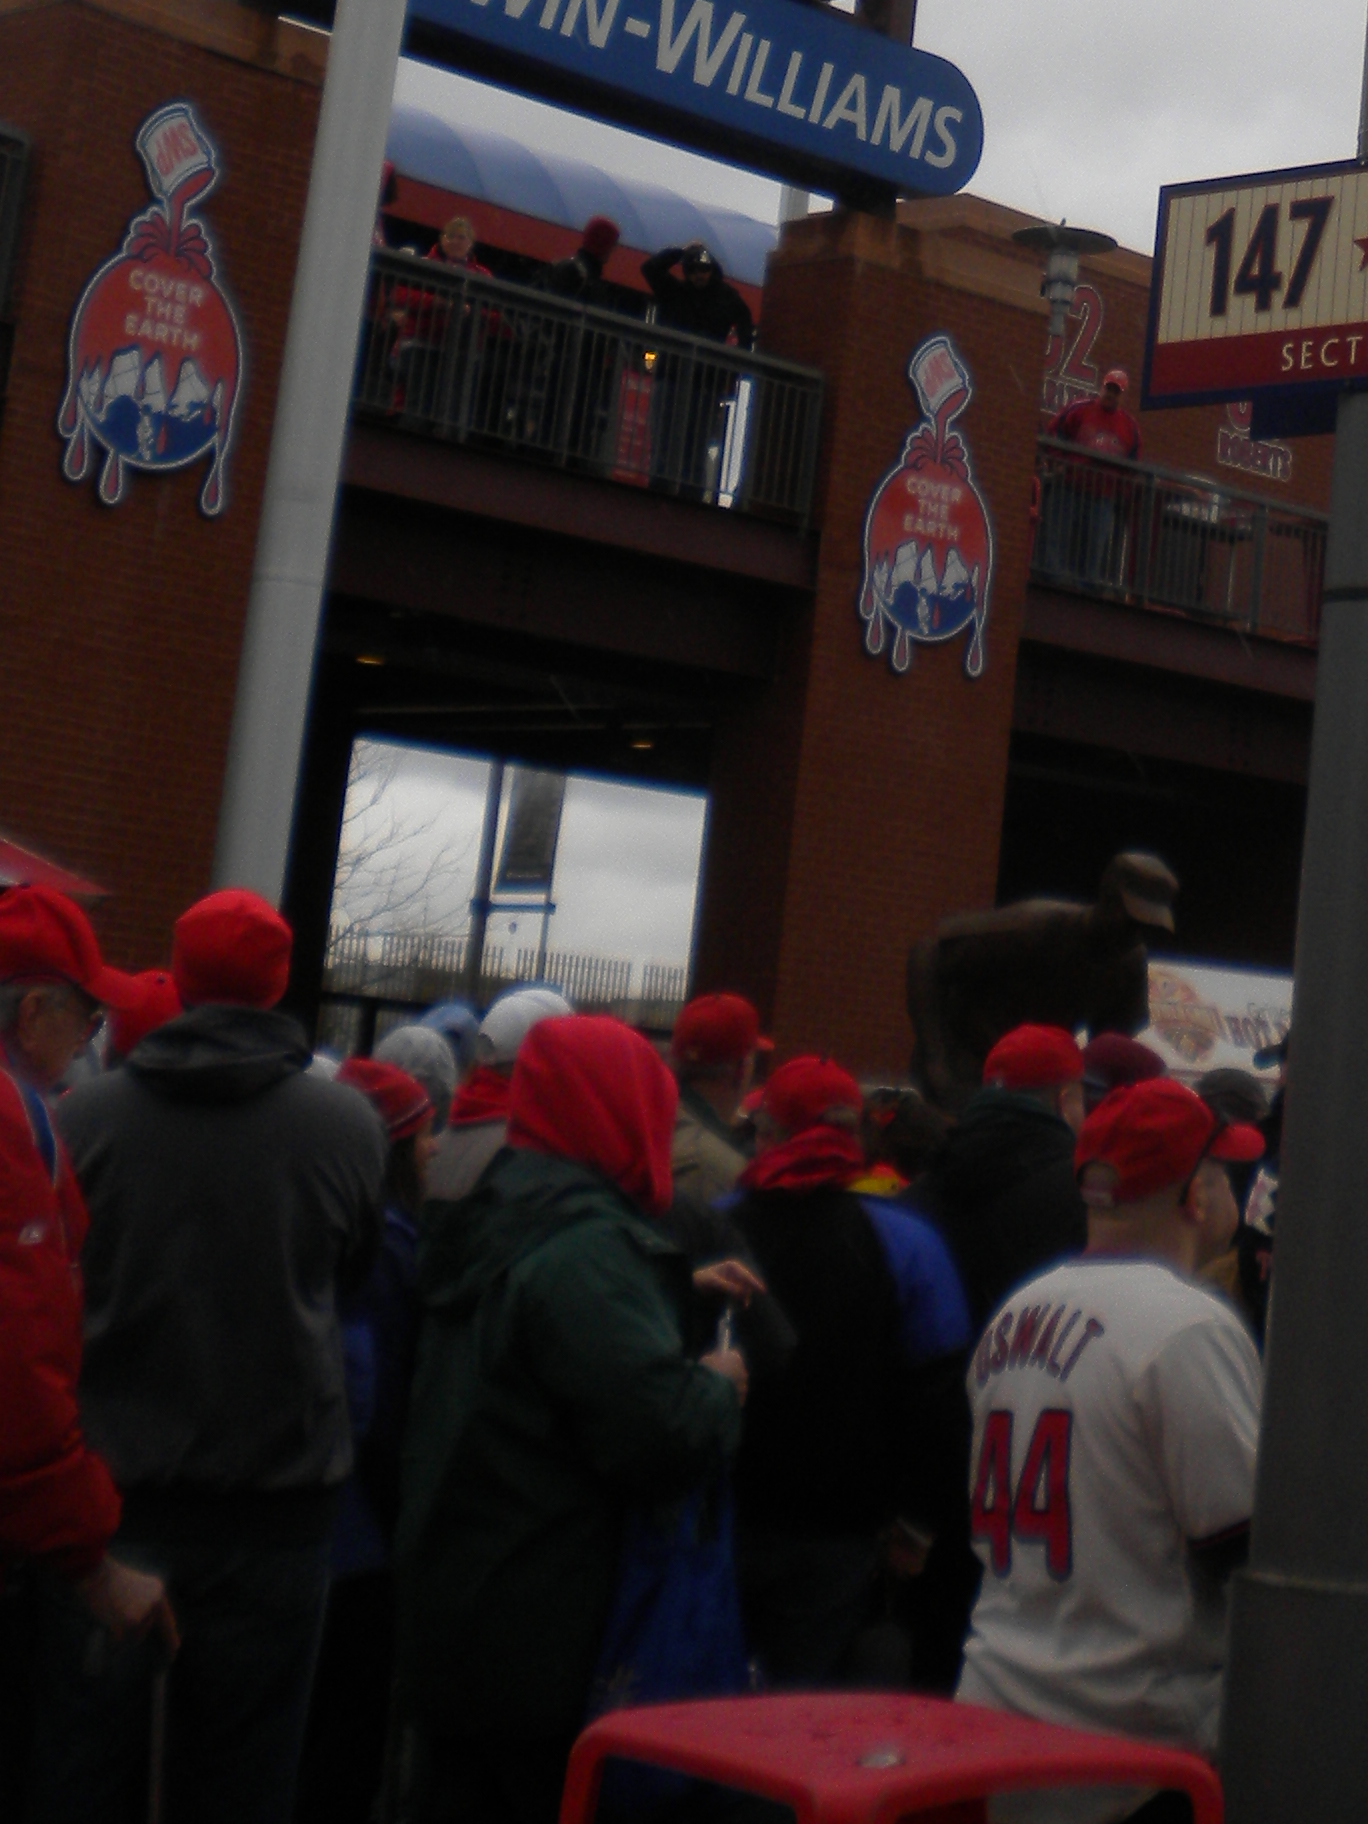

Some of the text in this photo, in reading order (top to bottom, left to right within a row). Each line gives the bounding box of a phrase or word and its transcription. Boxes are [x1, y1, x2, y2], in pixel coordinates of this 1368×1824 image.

[1205, 195, 1335, 317] 147
[128, 269, 204, 308] COVER
[144, 295, 187, 325] THE
[125, 312, 202, 351] EARTH
[906, 476, 962, 504] COVER
[904, 513, 959, 542] EARTH
[917, 498, 949, 522] THE
[975, 1303, 1104, 1387] OSWALT
[971, 1408, 1073, 1580] 44
